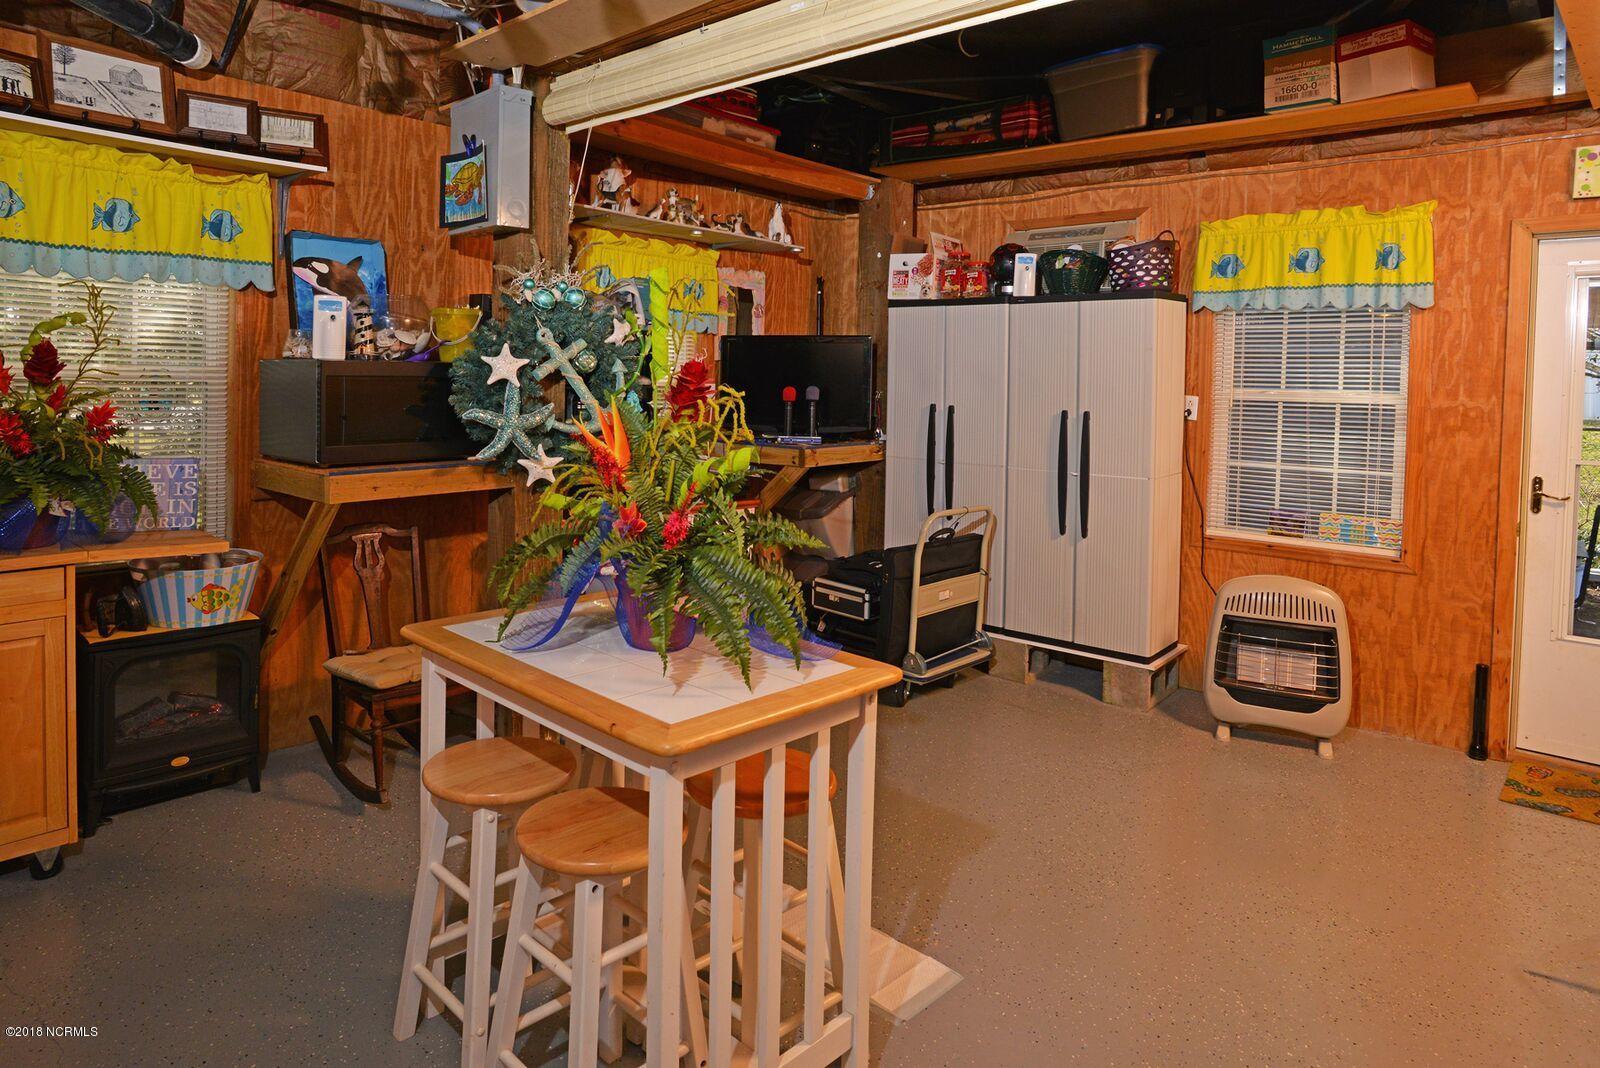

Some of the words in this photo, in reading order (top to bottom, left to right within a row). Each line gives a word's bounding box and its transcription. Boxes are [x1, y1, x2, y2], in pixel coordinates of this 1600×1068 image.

[1280, 81, 1317, 95] 16600-0
[174, 481, 197, 496] IS
[167, 498, 197, 514] IN
